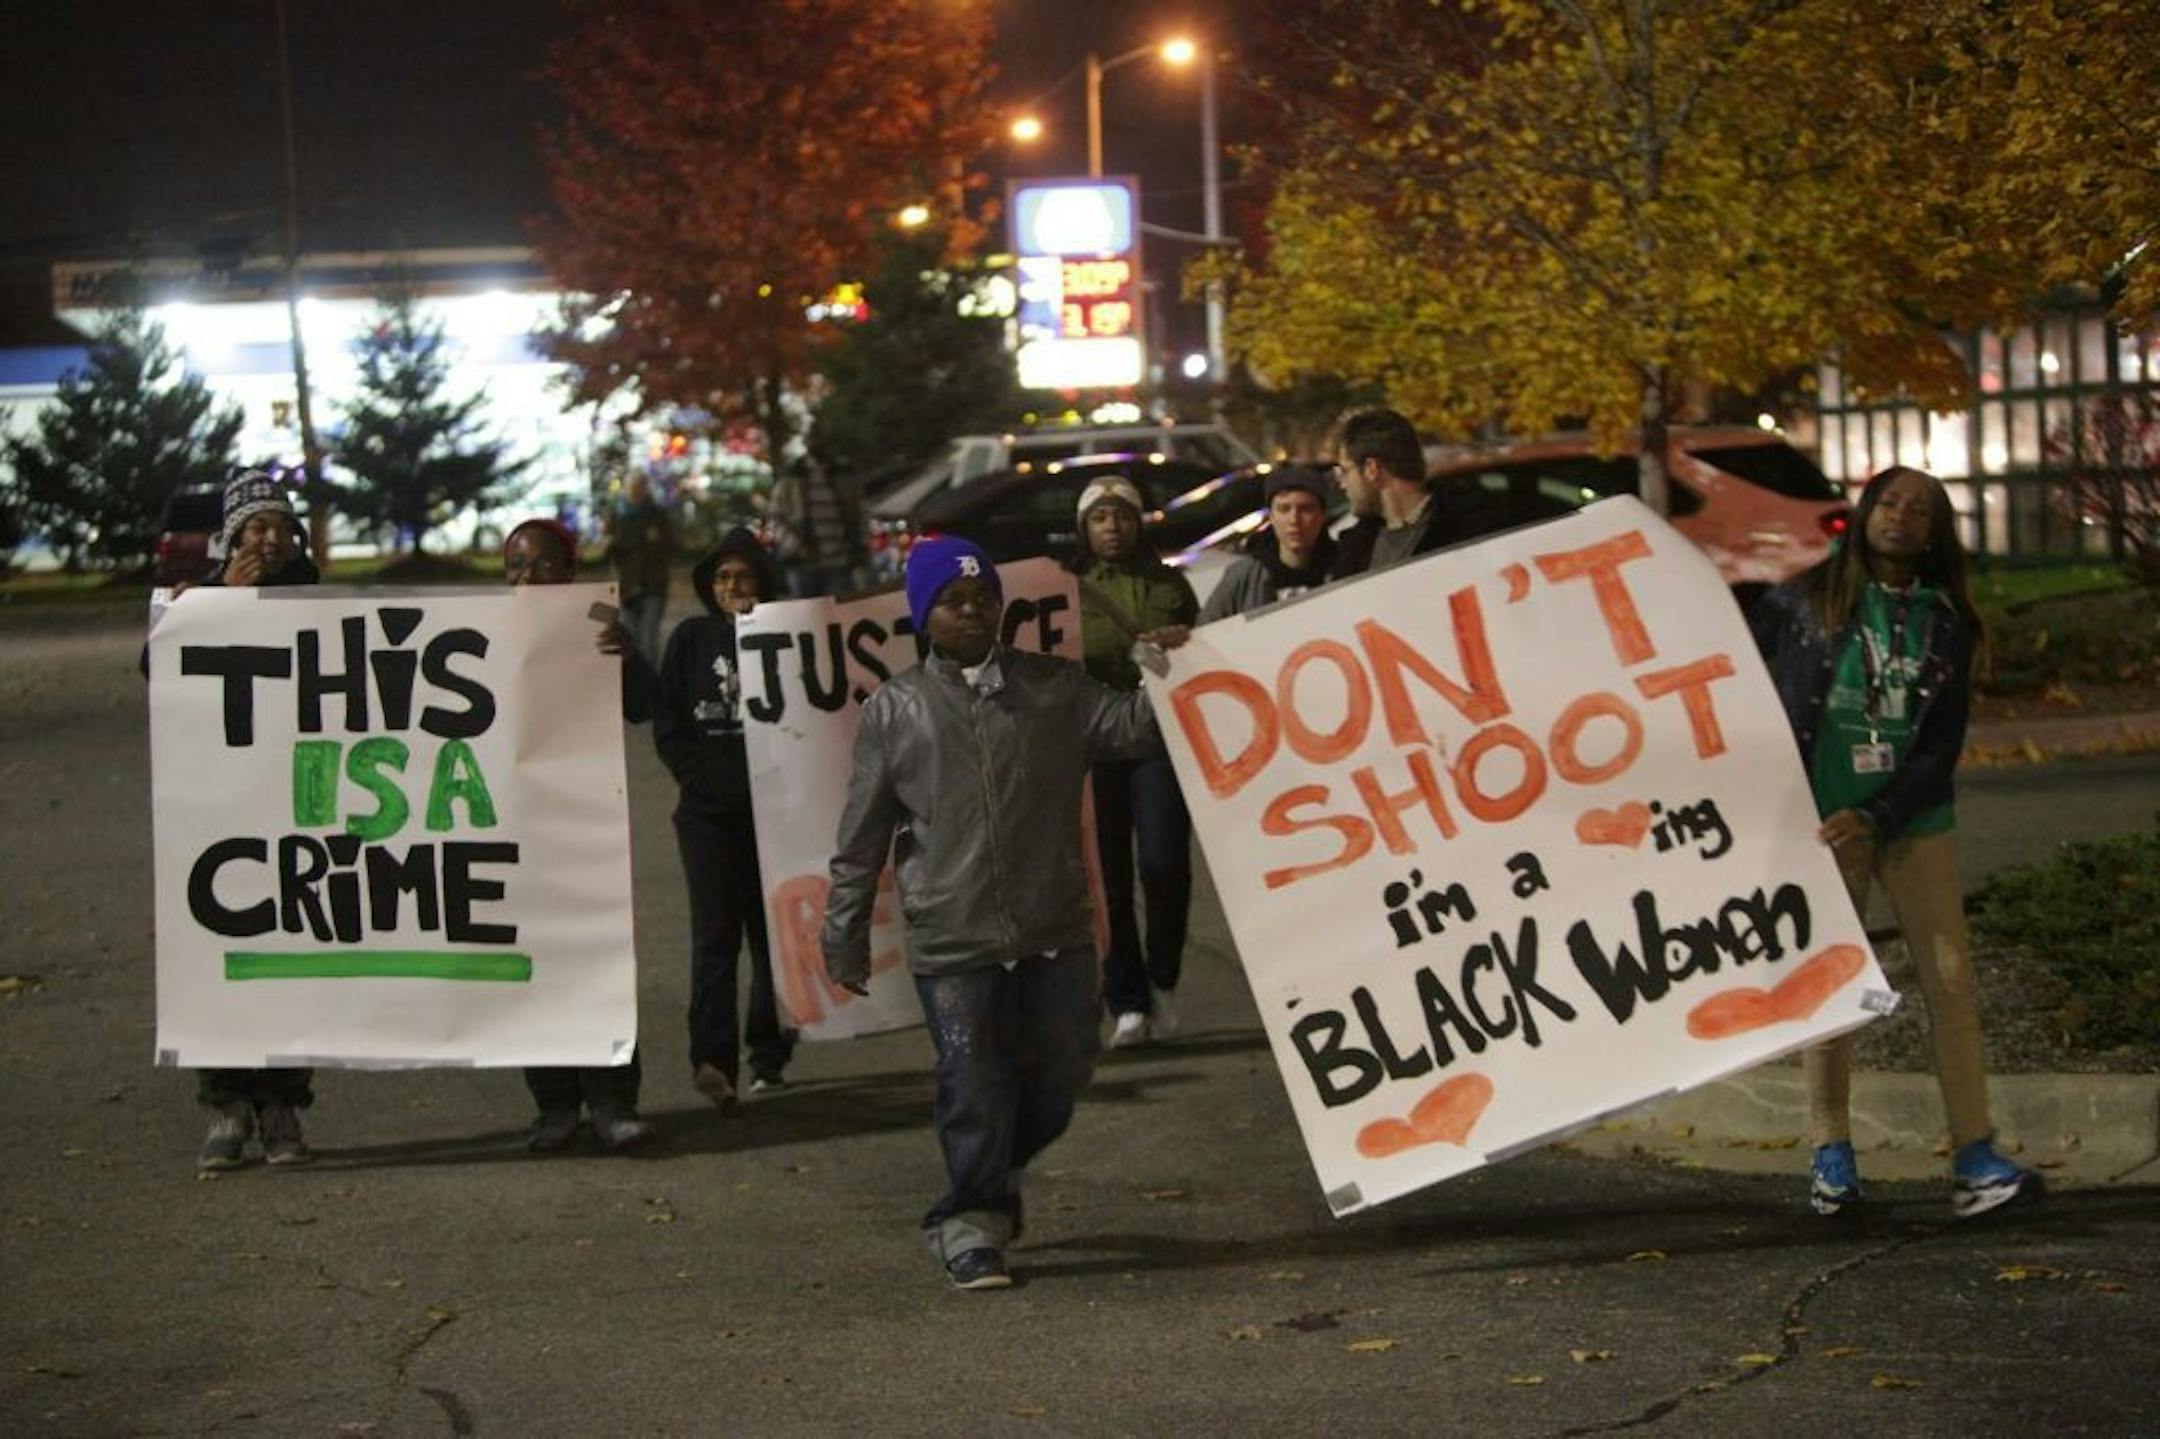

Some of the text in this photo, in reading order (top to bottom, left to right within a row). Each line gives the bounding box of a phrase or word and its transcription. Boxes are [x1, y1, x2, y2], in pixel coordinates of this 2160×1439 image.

[740, 595, 1068, 724] JUSCE
[1169, 530, 1654, 798] DON'T
[293, 736, 498, 842] IS A
[1260, 652, 1736, 890] SHOOT
[1384, 798, 1733, 950] i'm a ing
[1288, 882, 1812, 1108] BLACK Woman
